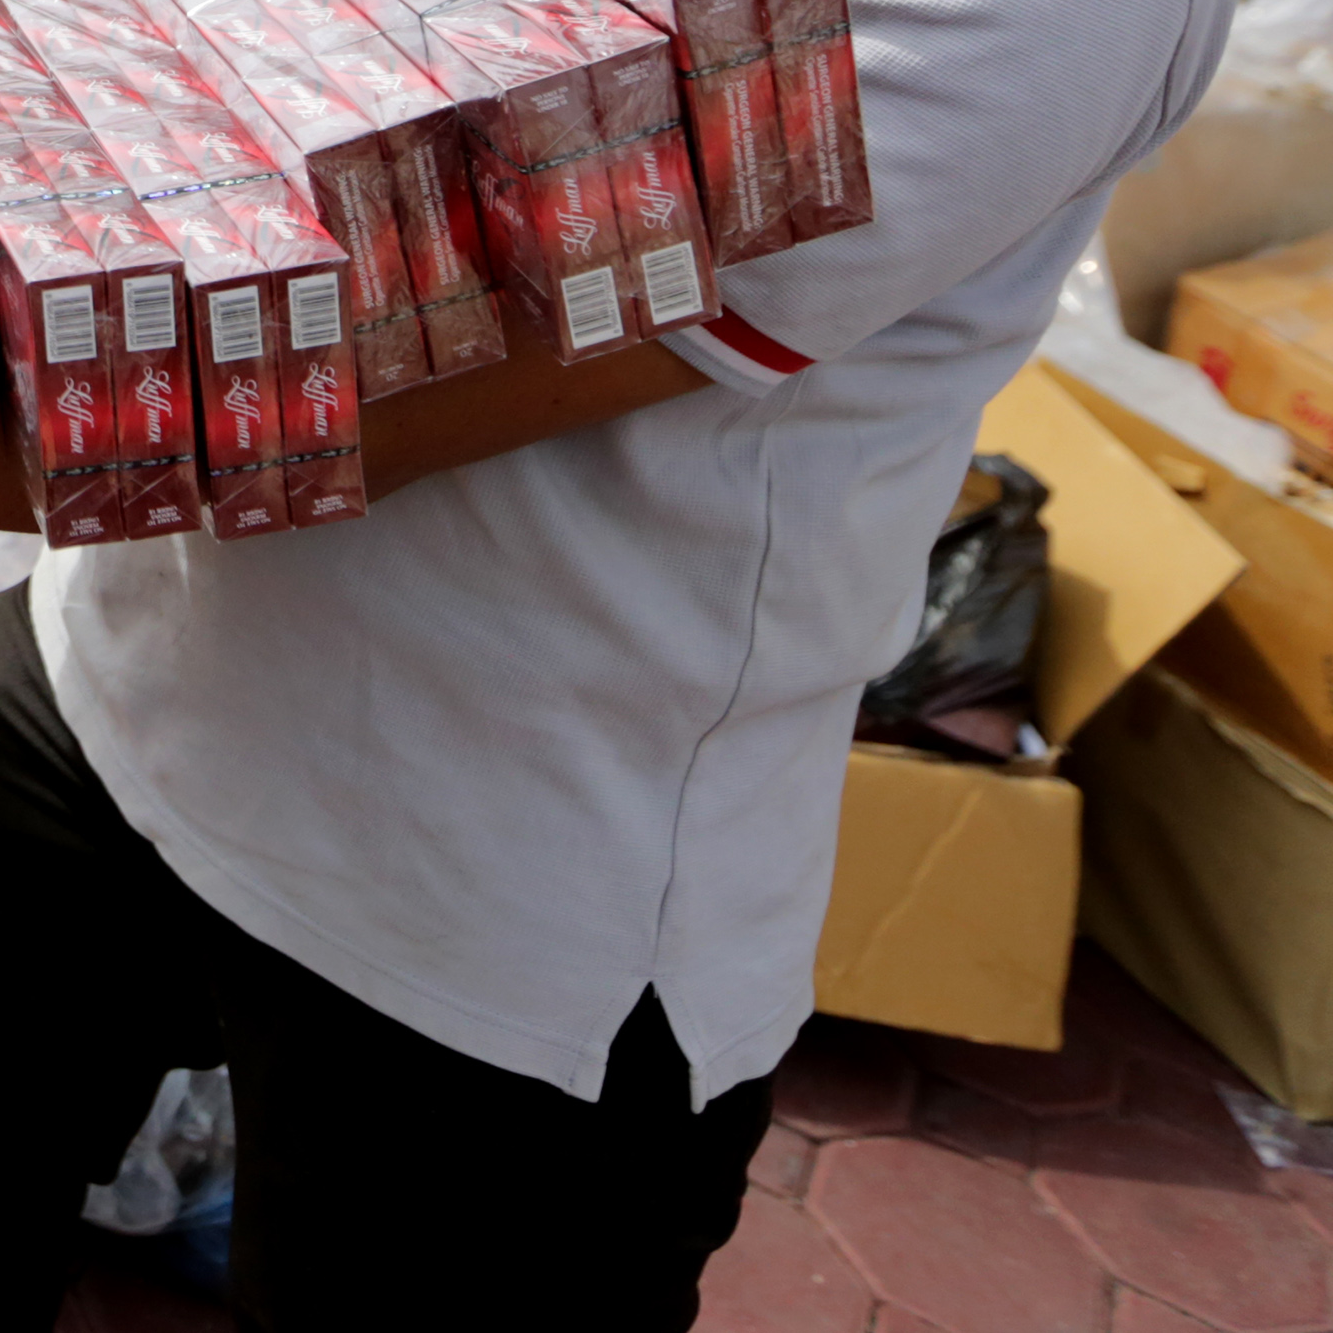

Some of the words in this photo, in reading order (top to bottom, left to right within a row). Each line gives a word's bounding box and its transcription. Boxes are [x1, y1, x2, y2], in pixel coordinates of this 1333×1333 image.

[555, 177, 597, 256] Luffman
[636, 151, 677, 231] Luffman
[57, 377, 95, 455] Luffman
[135, 366, 172, 445] Luffman
[224, 375, 262, 450] Luffman
[301, 362, 339, 438] Luffman
